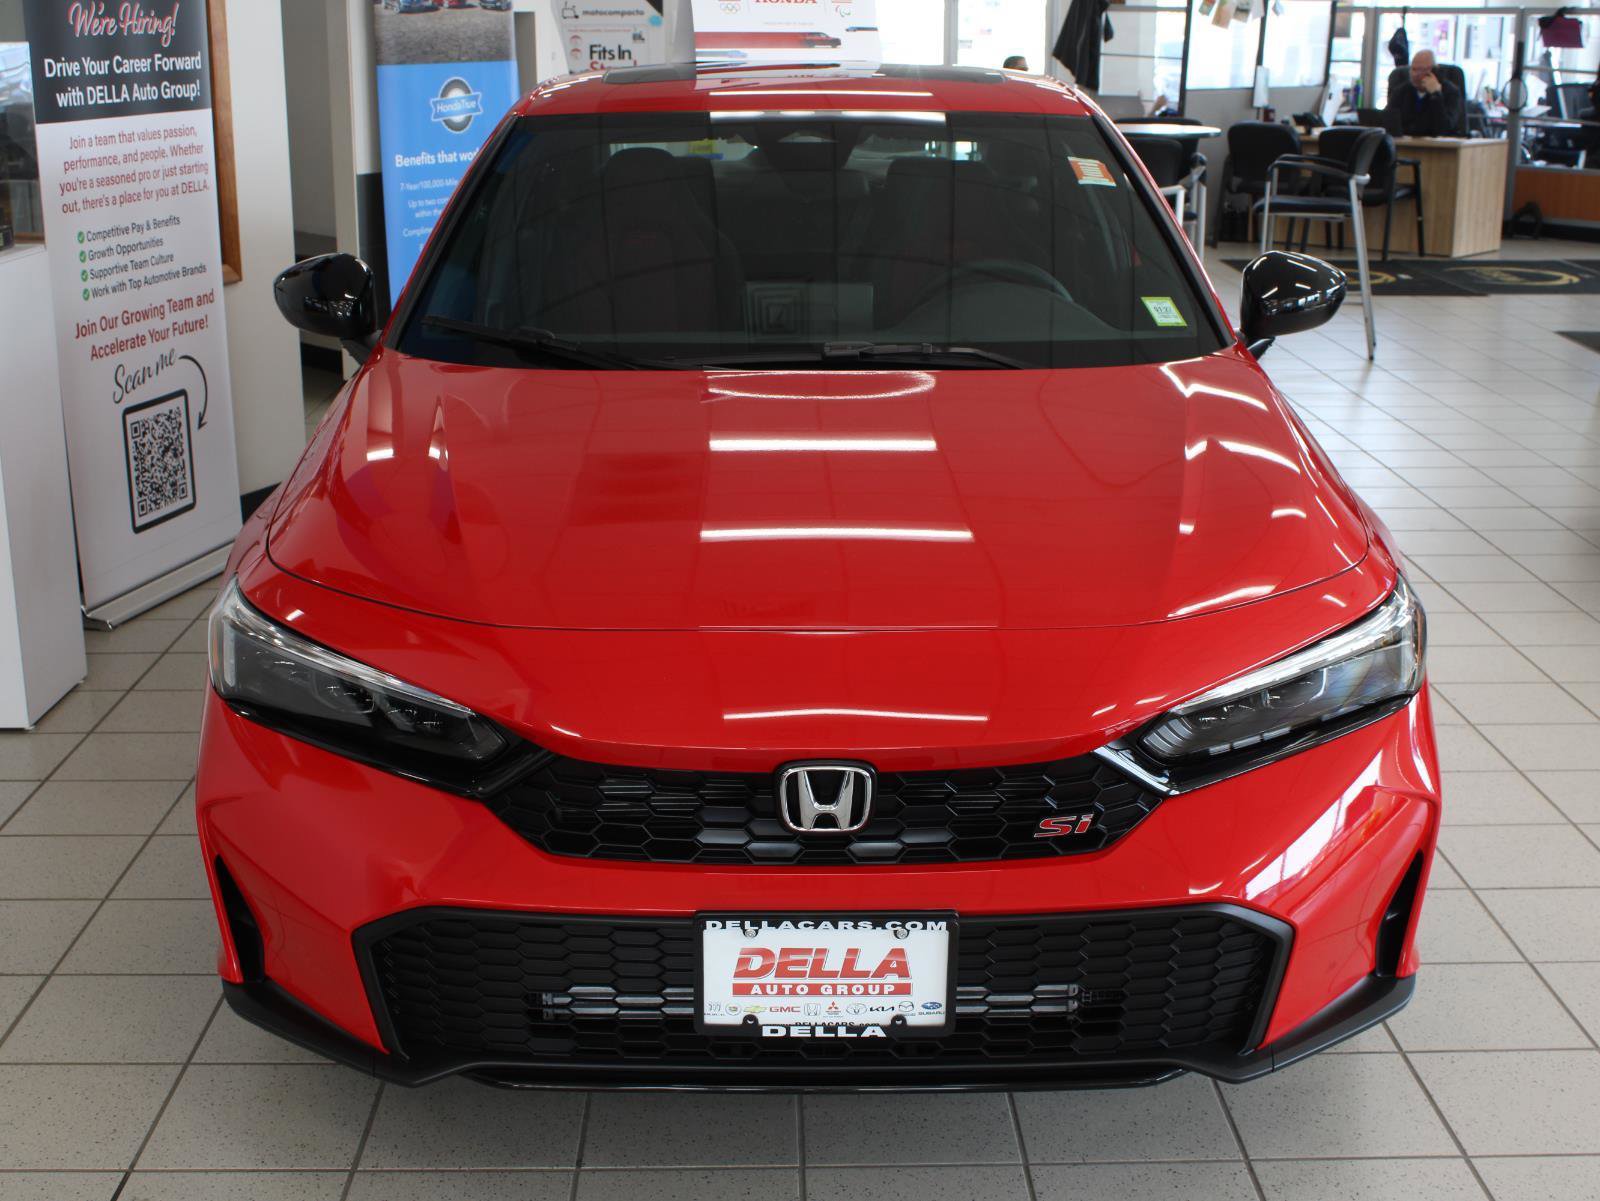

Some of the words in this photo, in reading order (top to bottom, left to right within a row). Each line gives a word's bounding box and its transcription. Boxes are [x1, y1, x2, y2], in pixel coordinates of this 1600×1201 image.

[68, 1, 117, 37] We're
[118, 1, 179, 47] Hiring!
[44, 58, 80, 78] Drive
[82, 57, 110, 75] Your
[113, 55, 151, 74] Career
[154, 51, 202, 71] Forward
[590, 45, 615, 60] Fits
[618, 45, 632, 60] In
[56, 87, 84, 107] with
[87, 83, 130, 105] DELLA
[132, 82, 158, 101] Auto
[161, 79, 200, 101] Group!
[70, 136, 86, 150] Join
[88, 139, 92, 147] a
[95, 134, 116, 146] team
[118, 130, 134, 144] that
[137, 128, 161, 140] values
[164, 124, 198, 142] passion,
[64, 156, 120, 174] performance,
[123, 150, 138, 164] and
[140, 148, 168, 165] people.
[170, 143, 204, 157] Whether
[395, 150, 436, 168] Benefits
[438, 149, 458, 163] that
[59, 178, 87, 196] you're
[90, 179, 94, 188] a
[96, 172, 136, 188] seasoned
[138, 171, 151, 184] pro
[153, 169, 160, 178] or
[162, 165, 177, 180] just
[179, 161, 209, 175] starting
[62, 201, 80, 214] out,
[82, 194, 110, 210] there's
[112, 196, 116, 206] a
[119, 190, 142, 208] place
[144, 187, 154, 200] for
[156, 187, 169, 202] you
[172, 184, 179, 196] at
[86, 224, 130, 242] Competitive
[131, 222, 144, 234] Pay
[146, 220, 151, 231] &
[154, 215, 180, 230] Benefits
[88, 246, 114, 261] Growth
[116, 237, 164, 256] Opportunities
[90, 262, 128, 280] Supportive
[130, 259, 149, 270] Team
[151, 252, 174, 266] Culture
[92, 285, 110, 299] Work
[112, 279, 127, 293] with
[128, 278, 142, 290] Top
[144, 270, 180, 286] Automotive
[182, 263, 206, 278] Brands
[76, 320, 97, 340] Join
[100, 316, 118, 332] Our
[122, 304, 166, 326] Growing
[166, 296, 194, 314] Team
[196, 288, 214, 307] and
[90, 333, 147, 361] Accelerate
[148, 328, 170, 344] Your
[172, 314, 208, 337] Future!
[113, 364, 152, 404] Scan
[156, 348, 175, 376] me
[1034, 814, 1094, 838] Si
[705, 920, 947, 931] DELLACARS.COM
[733, 948, 912, 980] DELLA
[751, 984, 809, 995] AUTO
[820, 984, 896, 996] GROUP
[762, 1026, 887, 1038] DELLA
